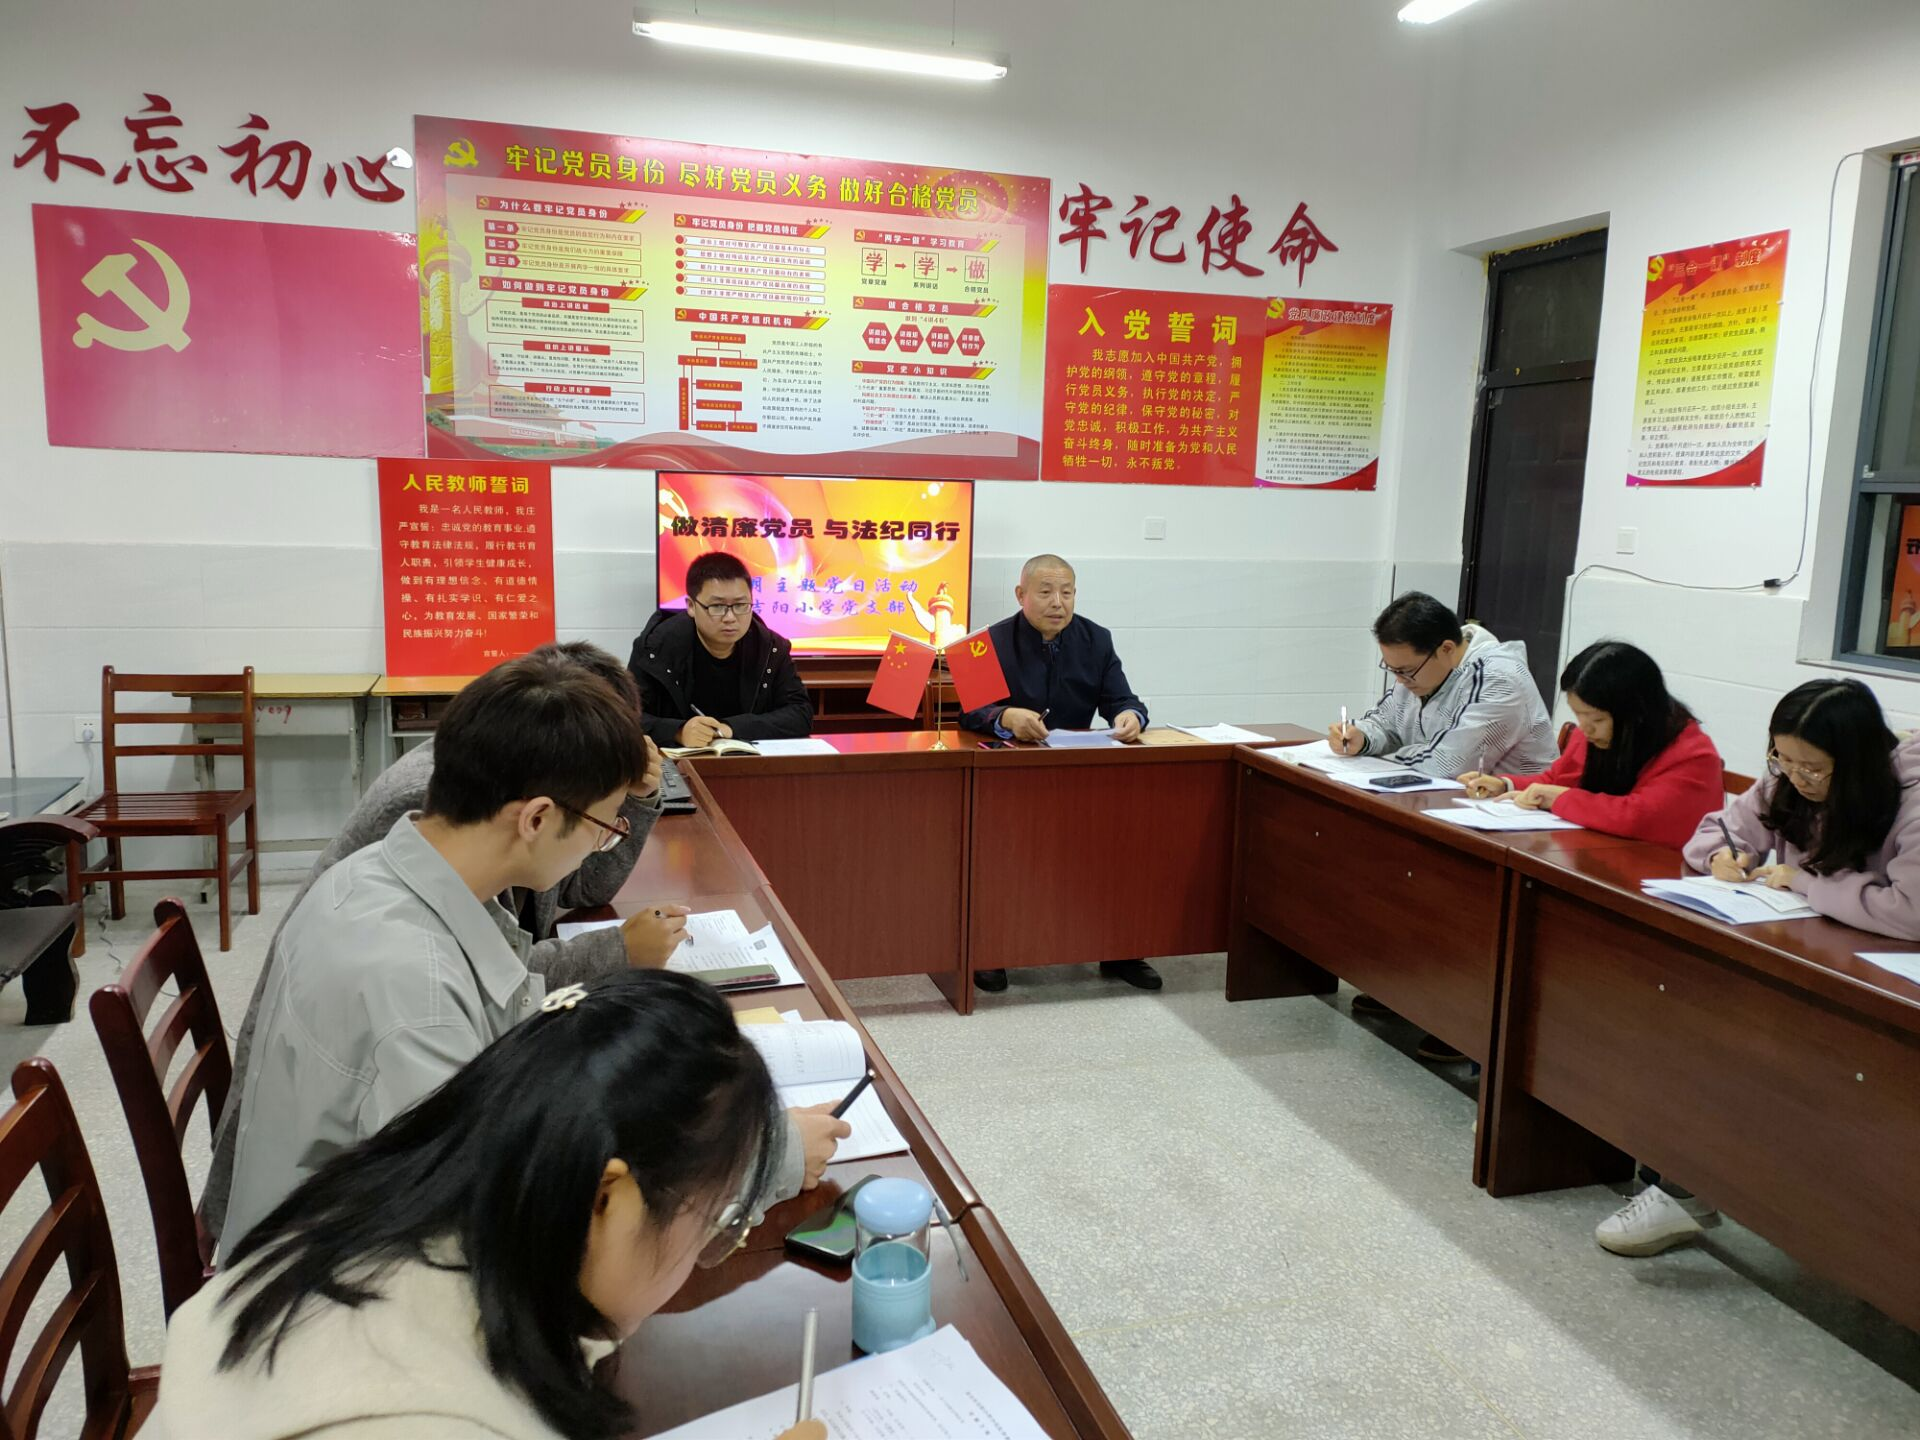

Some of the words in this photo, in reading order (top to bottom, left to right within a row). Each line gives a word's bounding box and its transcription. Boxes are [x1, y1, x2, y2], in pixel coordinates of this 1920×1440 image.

[13, 93, 410, 204] 不忘初心
[505, 145, 665, 185] 牢记党员身份
[679, 161, 827, 200] 尽好党员义务
[838, 177, 979, 213] 做好合格党员
[500, 200, 608, 218] 为什么要牢记党员身份
[692, 218, 744, 231] 牢记党员身份
[747, 224, 798, 235] 把握党员特征
[1058, 182, 1339, 289] 牢记使命
[866, 252, 883, 273] 学
[918, 256, 935, 276] 学
[969, 260, 985, 279] 做
[502, 280, 610, 296] 如何做到牢记党员身份
[888, 301, 949, 313] 做合格党员
[698, 312, 792, 326] 中国共产党组织机构
[1078, 307, 1238, 345] 入党誓词
[886, 365, 948, 375] 党史小知识
[402, 473, 529, 494] 人民教师誓词
[671, 516, 815, 539] 做清廉党员
[823, 519, 960, 542] 与法纪同行
